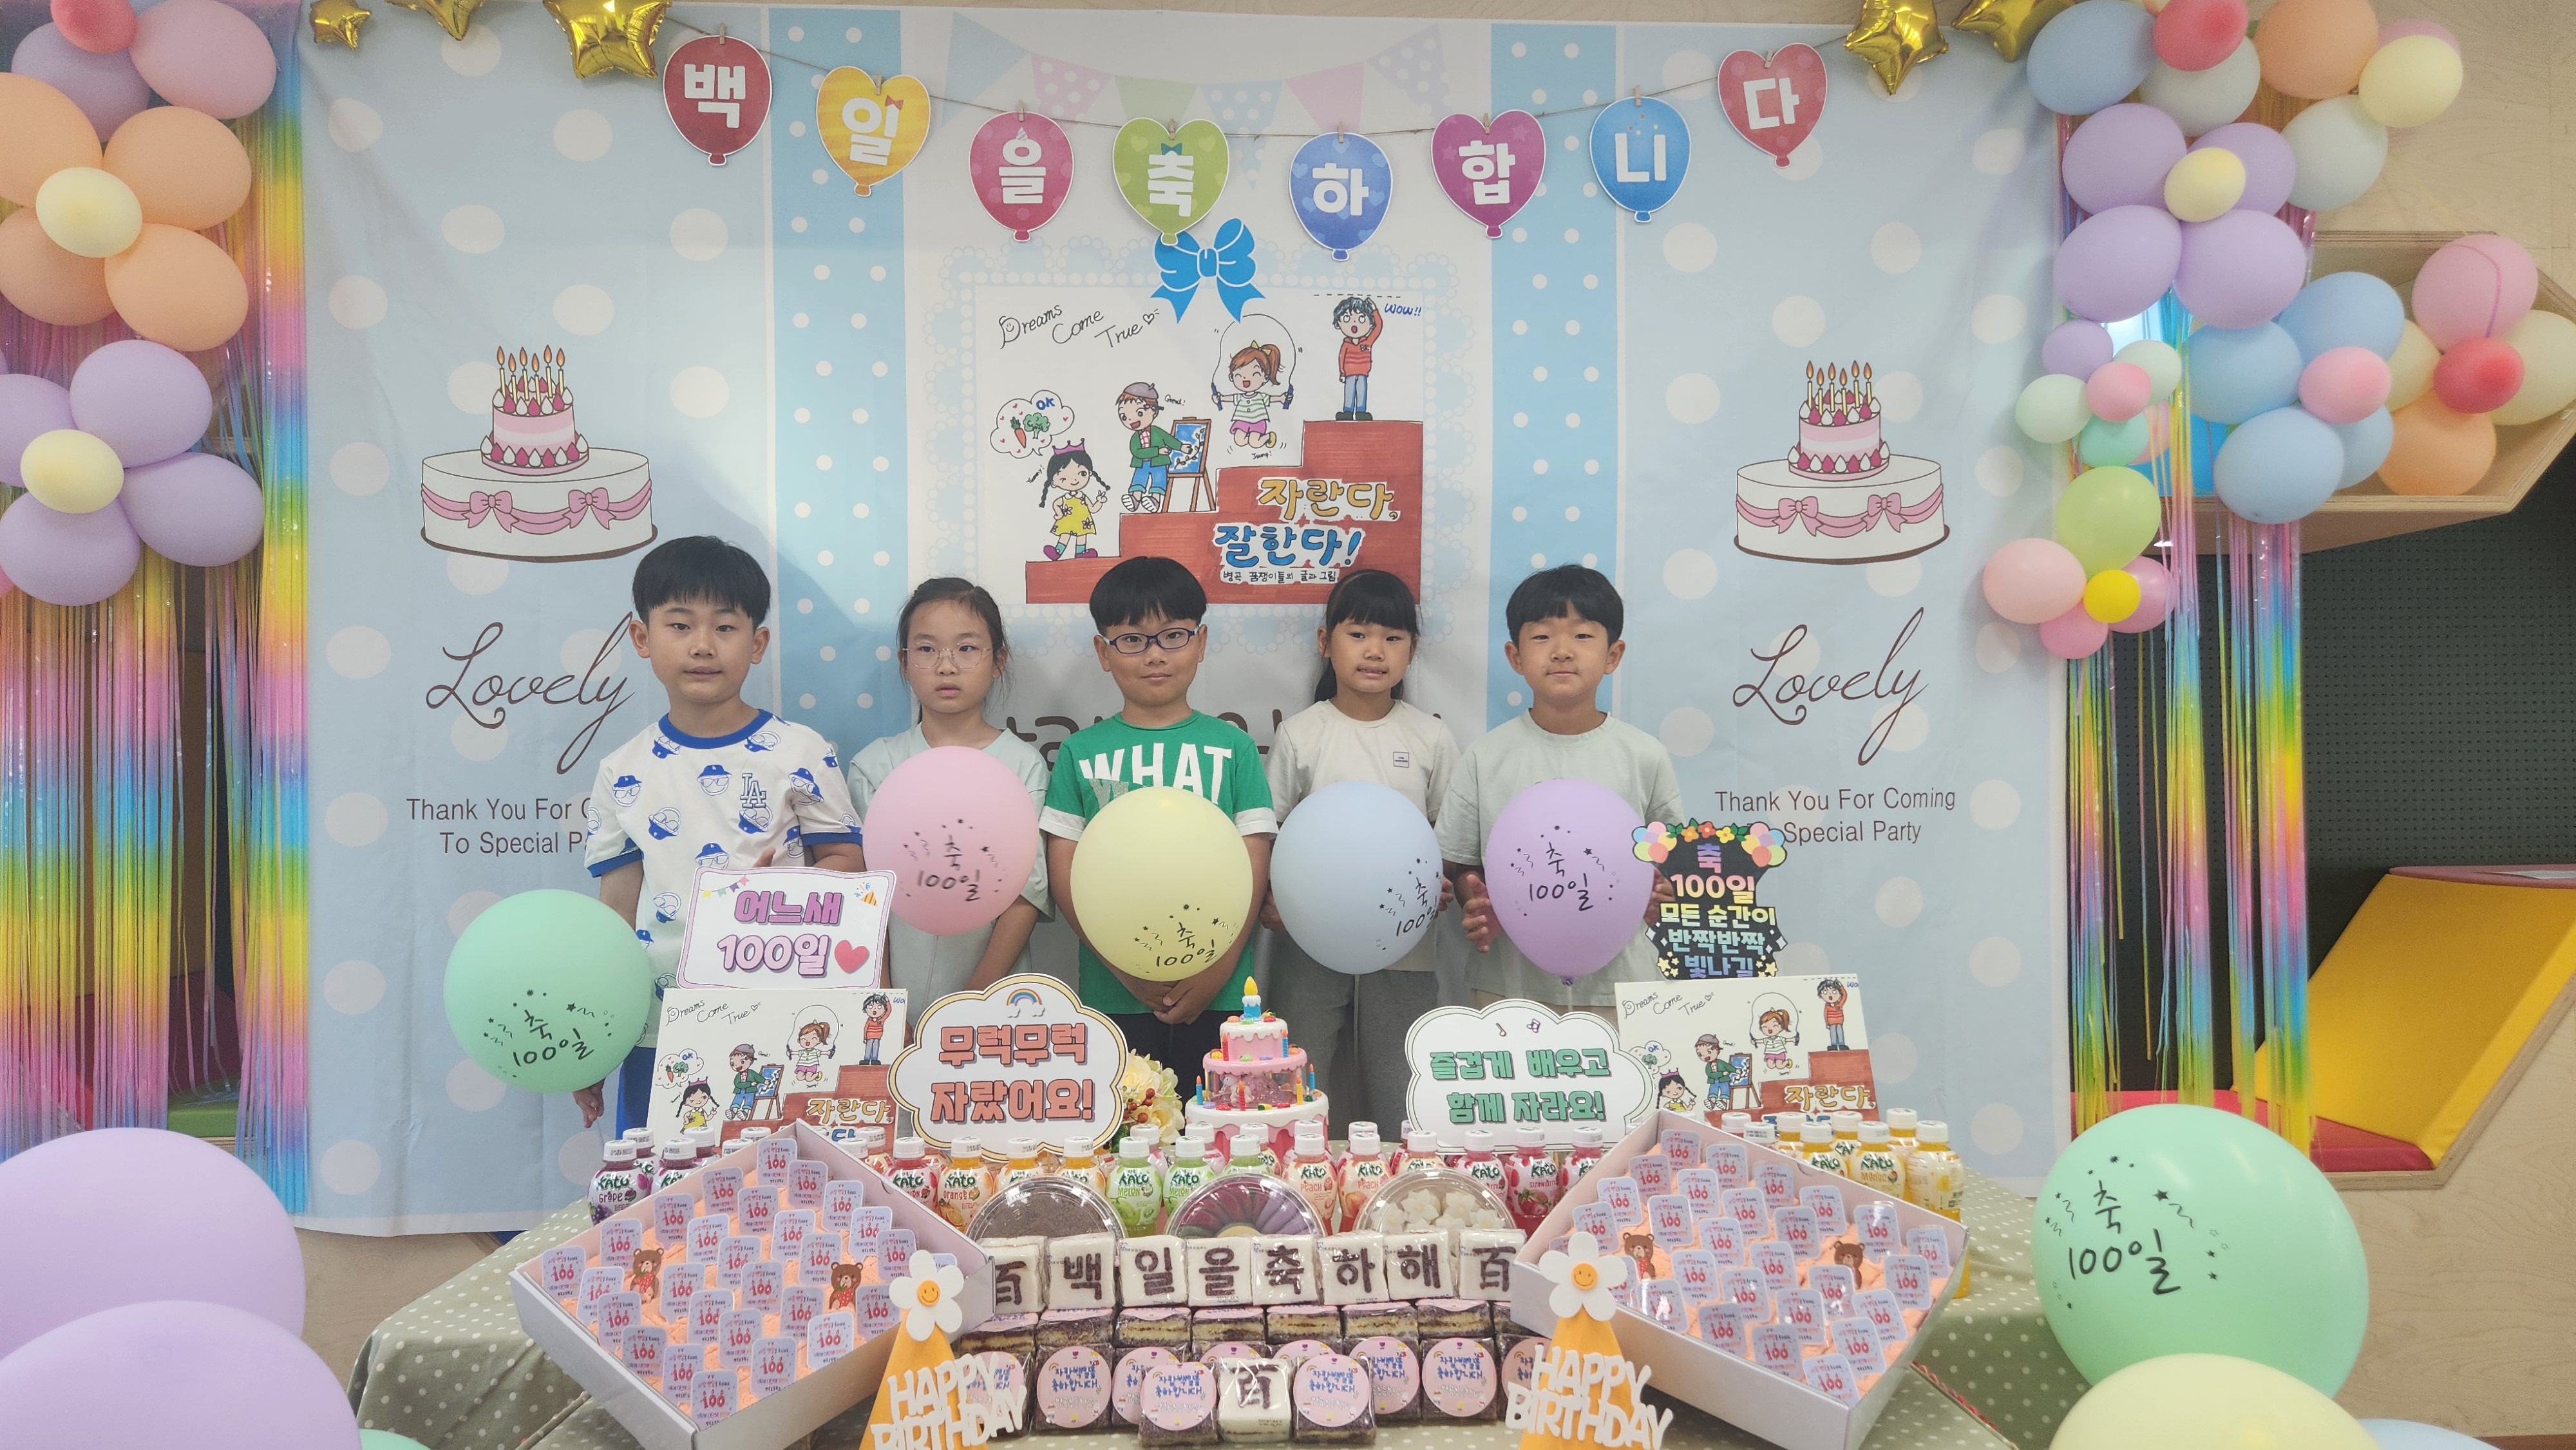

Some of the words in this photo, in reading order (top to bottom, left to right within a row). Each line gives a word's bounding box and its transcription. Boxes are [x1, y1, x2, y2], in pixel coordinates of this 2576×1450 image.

[683, 63, 746, 129] 백
[842, 96, 901, 166] 일
[998, 138, 1046, 205] 을
[1148, 149, 1195, 218] 축
[1312, 162, 1370, 216] 하
[1458, 140, 1516, 205] 합
[1615, 131, 1667, 183] 니
[1743, 76, 1800, 129] 다
[999, 305, 1062, 349] Dreams
[1052, 311, 1104, 344] Come
[1094, 324, 1144, 348] True
[1036, 397, 1056, 410] OK
[1215, 525, 1361, 568] 잘한다!
[1223, 571, 1242, 581] 병곡
[1319, 571, 1336, 581] 그림
[426, 610, 636, 775] Lovely
[1732, 607, 1929, 767] Lovely
[1079, 742, 1232, 806] WHAT
[740, 773, 766, 808] LA
[1715, 790, 1781, 812] Thank
[1788, 790, 1829, 811] You
[1839, 788, 1874, 810] For
[1884, 787, 1956, 811] Coming
[406, 798, 478, 821] Thank
[486, 798, 526, 820] You
[536, 798, 572, 820] For
[440, 832, 469, 854] To
[480, 831, 559, 857] Special
[1784, 821, 1864, 846] Special
[1874, 820, 1921, 844] Party
[943, 834, 963, 871] 축
[1546, 842, 1565, 877] 축
[1697, 843, 1721, 873] 축
[918, 869, 981, 901] 100일
[1416, 877, 1428, 907] 축
[1530, 872, 1594, 911] 100일
[1670, 874, 1755, 904] 100일
[734, 890, 844, 925] 어느새
[1661, 903, 1700, 927] 모든
[1707, 905, 1776, 928] 순간이
[1177, 922, 1195, 948] 축
[1668, 929, 1765, 955] 반짝반짝
[717, 933, 831, 977] 100일
[1156, 939, 1217, 966] 100일
[1684, 955, 1754, 979] 빛나길
[666, 999, 705, 1026] Dreams
[696, 1001, 729, 1023] Come
[721, 1010, 752, 1024] True
[1624, 992, 1658, 1019] Dreams
[1653, 995, 1683, 1015] Come
[1678, 1001, 1706, 1016] True
[525, 1010, 552, 1040] 축
[513, 1028, 594, 1067] 100일
[682, 1052, 694, 1061] OK
[939, 1022, 1086, 1066] 무럭무럭
[1430, 1051, 1513, 1080] 즐겁게
[1526, 1048, 1611, 1077] 배우고
[930, 1078, 1094, 1122] 자랐어요!
[1446, 1092, 1506, 1124] 함께
[1511, 1090, 1606, 1120] 자라요!
[1670, 1149, 1688, 1159] 100
[797, 1180, 817, 1191] 100
[1640, 1173, 1660, 1183] 100
[714, 1188, 734, 1200] 100
[1688, 1189, 1708, 1200] 100
[748, 1206, 768, 1218] 100
[1736, 1209, 1756, 1220] 100
[2094, 1180, 2121, 1234] 축
[1661, 1216, 1681, 1228] 100
[1867, 1227, 1888, 1238] 100
[697, 1236, 717, 1248] 100
[782, 1229, 802, 1241] 100
[1711, 1238, 1732, 1250] 100
[886, 1252, 905, 1262] 100
[2069, 1229, 2181, 1295] 100일
[1063, 1252, 1102, 1300] 백
[1135, 1247, 1175, 1295] 일
[1199, 1247, 1240, 1296] 을
[1264, 1244, 1304, 1294] 축
[1332, 1247, 1375, 1293] 하
[1397, 1244, 1441, 1288] 해
[1472, 1246, 1516, 1292] 百
[1684, 1272, 1705, 1283] 100
[1763, 1265, 1783, 1275] 100
[752, 1284, 772, 1295] 100
[1737, 1291, 1756, 1302] 100
[791, 1309, 811, 1321] 100
[1789, 1312, 1811, 1324] 100
[729, 1334, 751, 1346] 100
[817, 1335, 840, 1348] 100
[1846, 1342, 1869, 1355] 100
[633, 1348, 655, 1359] 100
[761, 1362, 784, 1374] 100
[1531, 1344, 1652, 1405] HAPPY
[887, 1353, 999, 1418] HAPPY
[1819, 1378, 1843, 1391] 100
[702, 1395, 725, 1408] 100
[1505, 1381, 1673, 1450] BIRTHDAY
